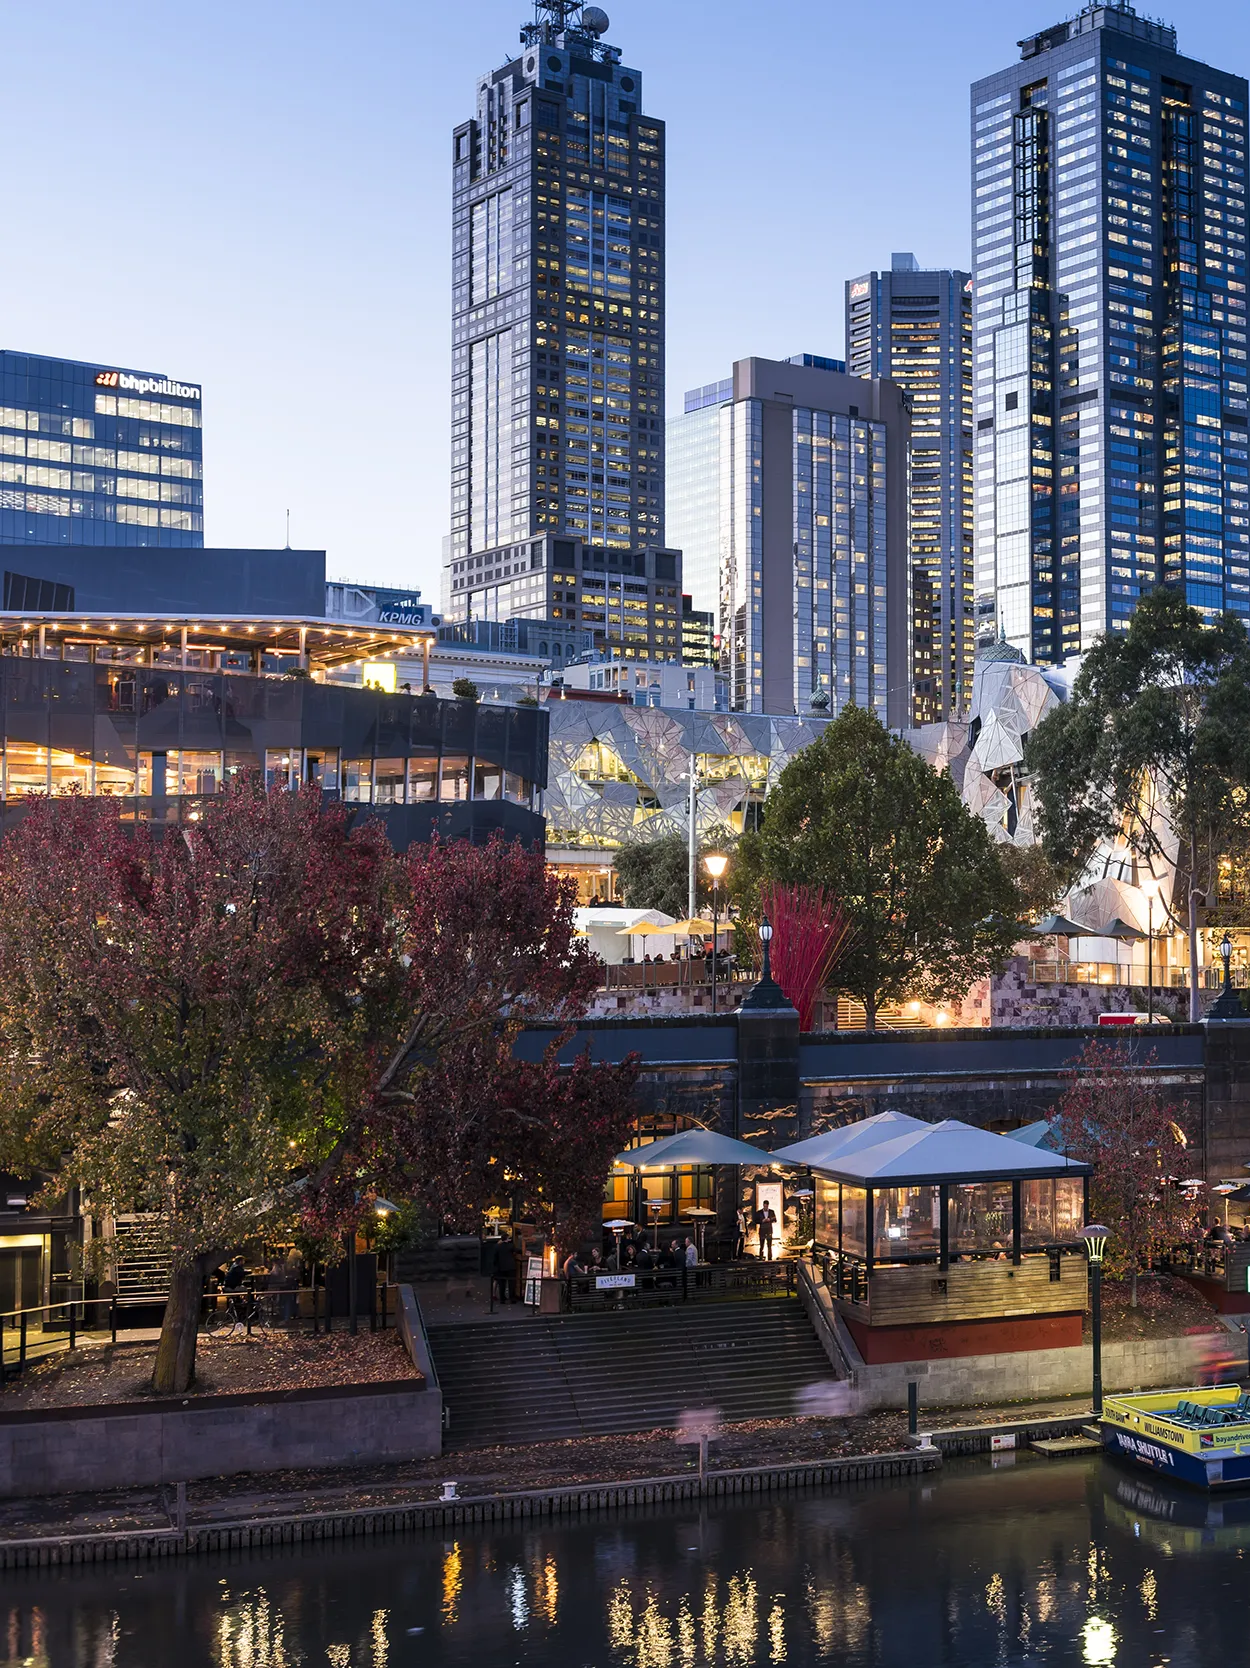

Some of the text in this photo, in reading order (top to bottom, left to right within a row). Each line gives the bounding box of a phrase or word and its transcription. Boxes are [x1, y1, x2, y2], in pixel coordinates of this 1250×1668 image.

[379, 611, 422, 626] KPMG
[1144, 1421, 1185, 1444] WILLIAMSTOWN
[1136, 1440, 1168, 1464] SHUTTLE
[1168, 1452, 1175, 1467] 1
